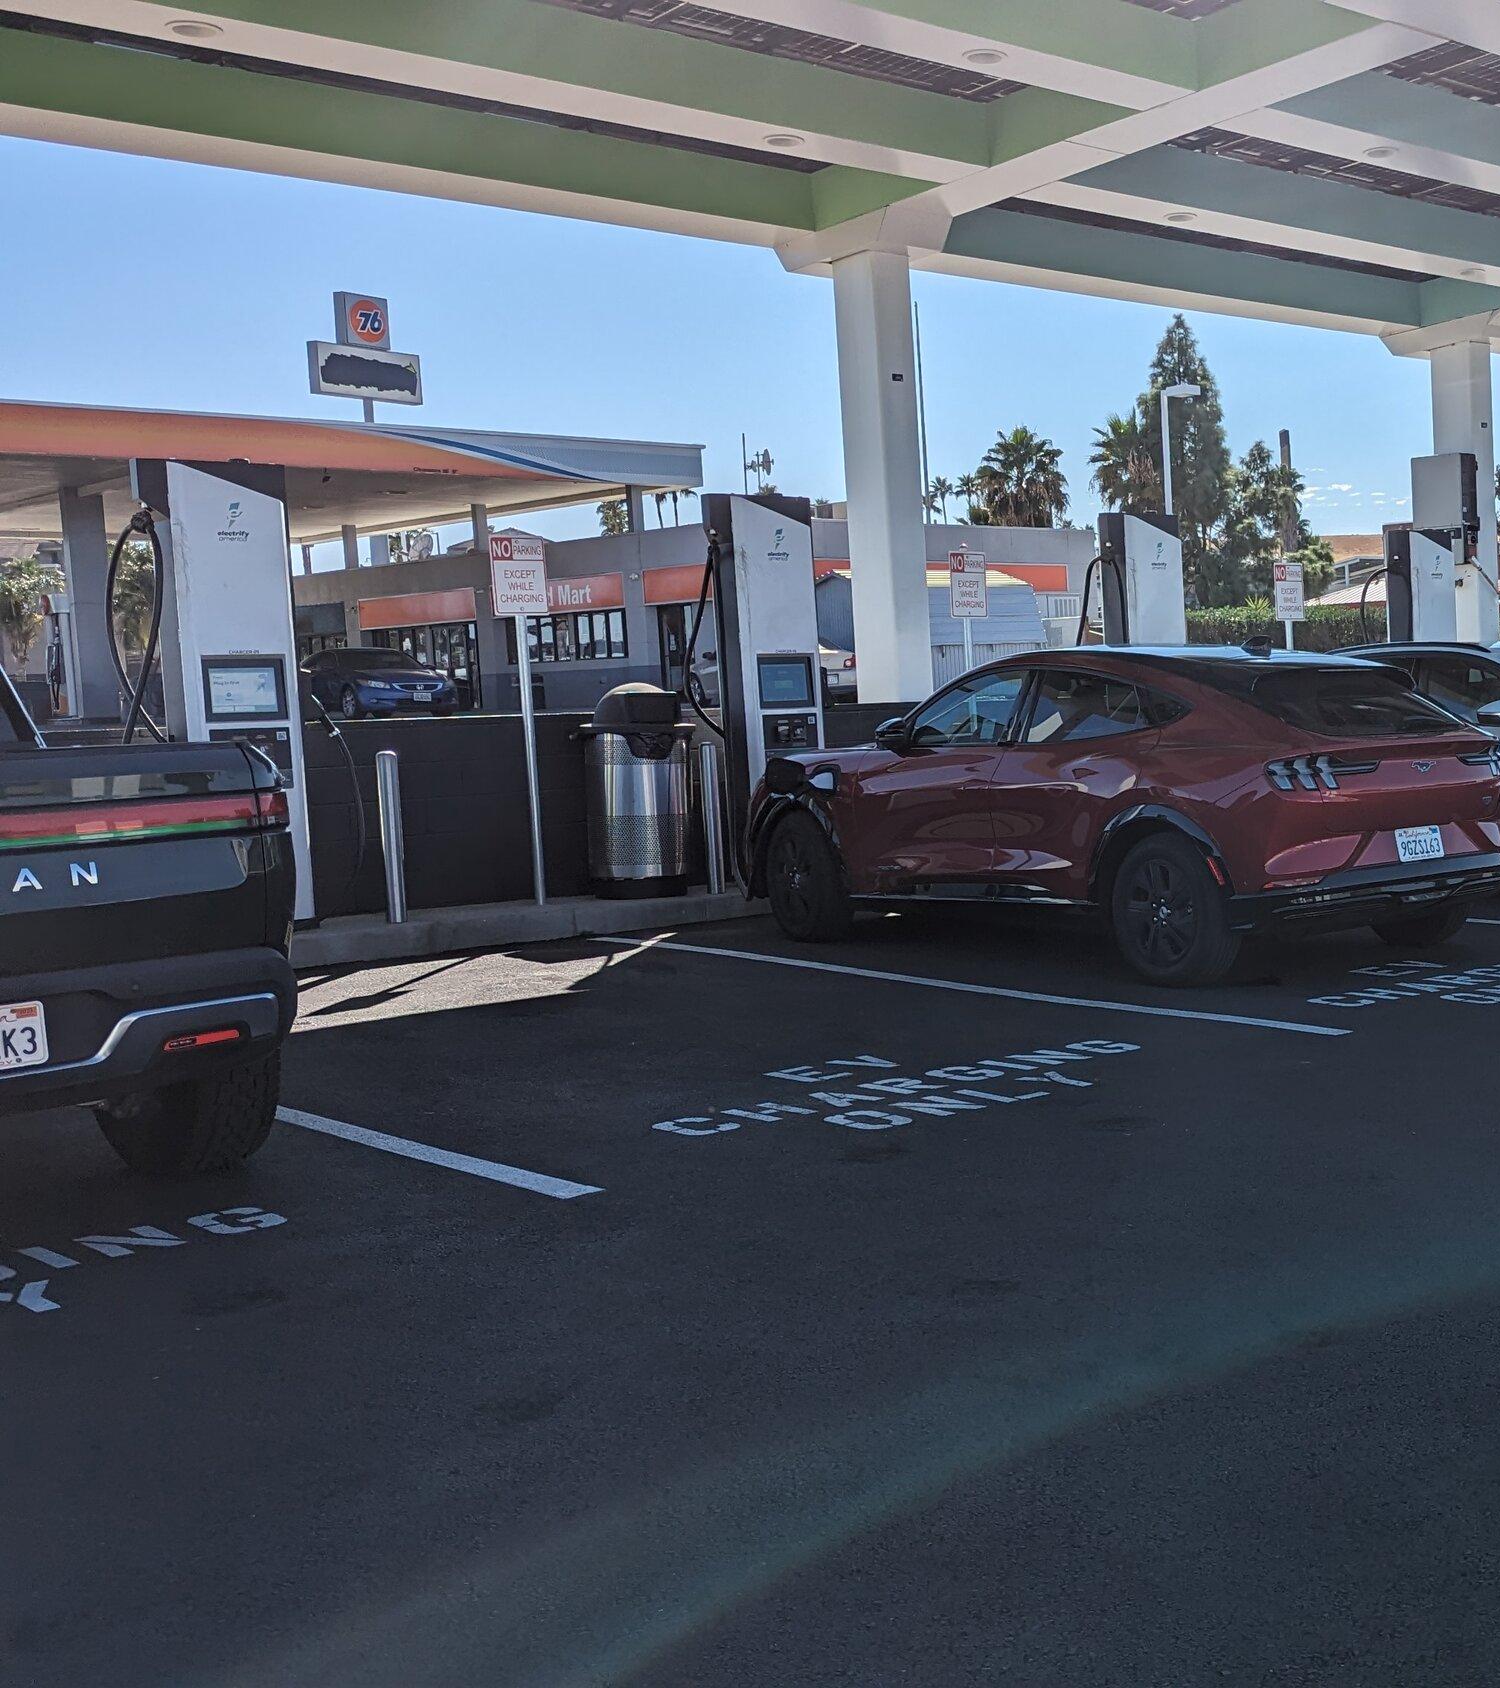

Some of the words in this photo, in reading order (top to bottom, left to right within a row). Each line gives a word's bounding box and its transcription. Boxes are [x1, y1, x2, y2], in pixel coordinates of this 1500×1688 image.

[358, 310, 383, 334] 76
[491, 540, 511, 558] NO
[513, 545, 541, 556] PARKING
[951, 555, 964, 570] NO
[504, 569, 536, 579] EXCEPT
[1275, 566, 1286, 580] NO
[508, 582, 534, 591] WHILE
[958, 580, 979, 588] EXCEPT
[501, 594, 544, 604] CHARGING
[558, 584, 592, 606] Mart
[1400, 837, 1441, 857] 9GZS163
[1348, 960, 1449, 977] EV
[762, 1054, 900, 1083] EV
[651, 1039, 1141, 1136] CHARGING
[822, 1071, 1093, 1131] ONLY
[0, 1206, 288, 1281] ING
